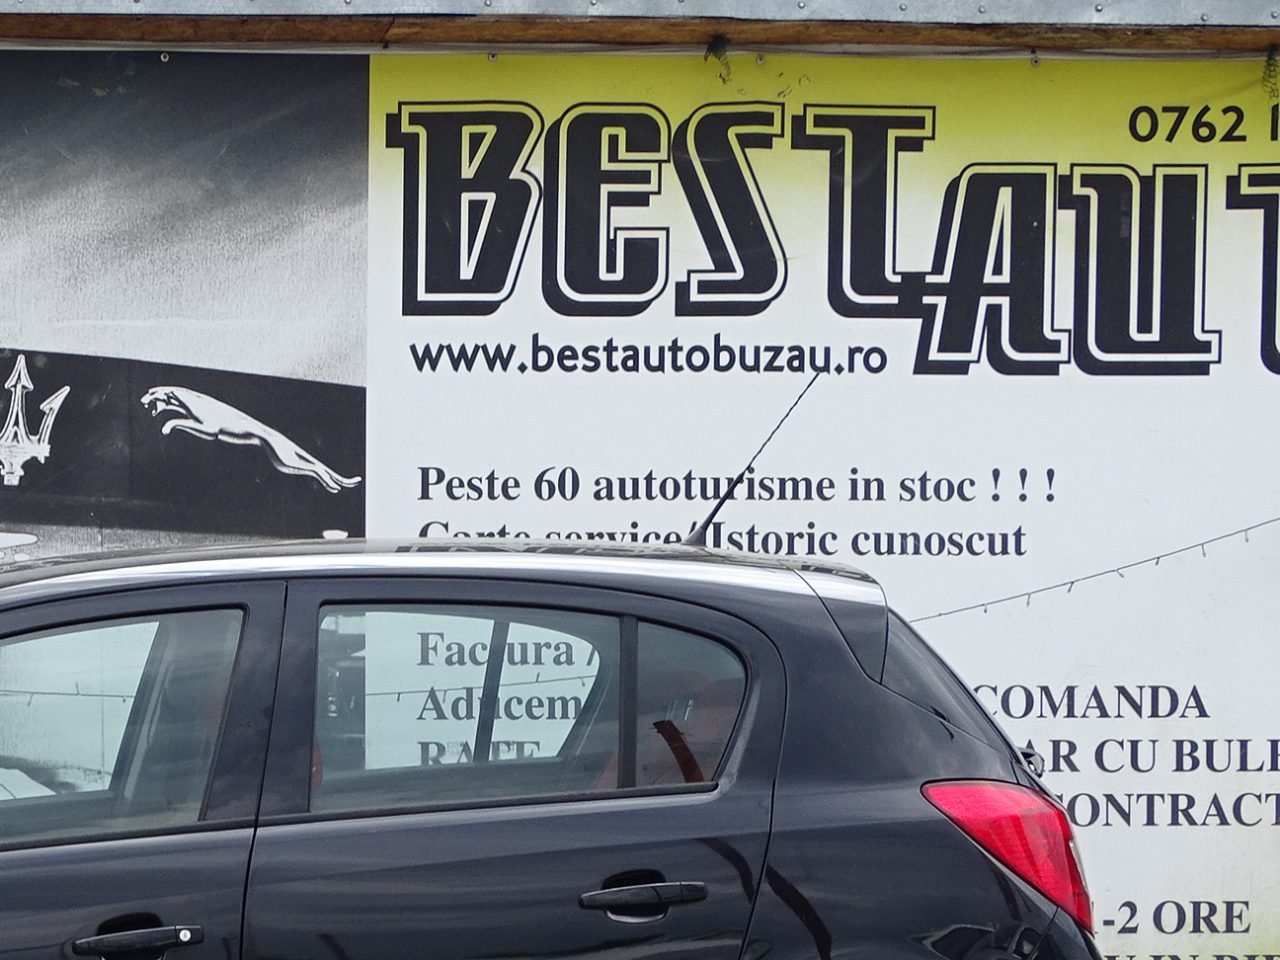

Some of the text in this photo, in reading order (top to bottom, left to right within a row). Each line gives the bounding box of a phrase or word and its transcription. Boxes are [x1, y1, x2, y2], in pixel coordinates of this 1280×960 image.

[1128, 104, 1247, 143] 0762
[409, 333, 888, 375] www.bestautobuzau.ro
[417, 466, 521, 502] Peste
[534, 466, 580, 502] 60
[593, 466, 835, 502] autoturisme
[849, 466, 886, 502] in
[899, 470, 976, 502] stoc
[851, 526, 1027, 557] cunoscut
[416, 632, 576, 667] Facura
[1094, 738, 1160, 774] CU
[1054, 792, 1280, 828] ONTRACT
[1152, 900, 1252, 935] ORE
